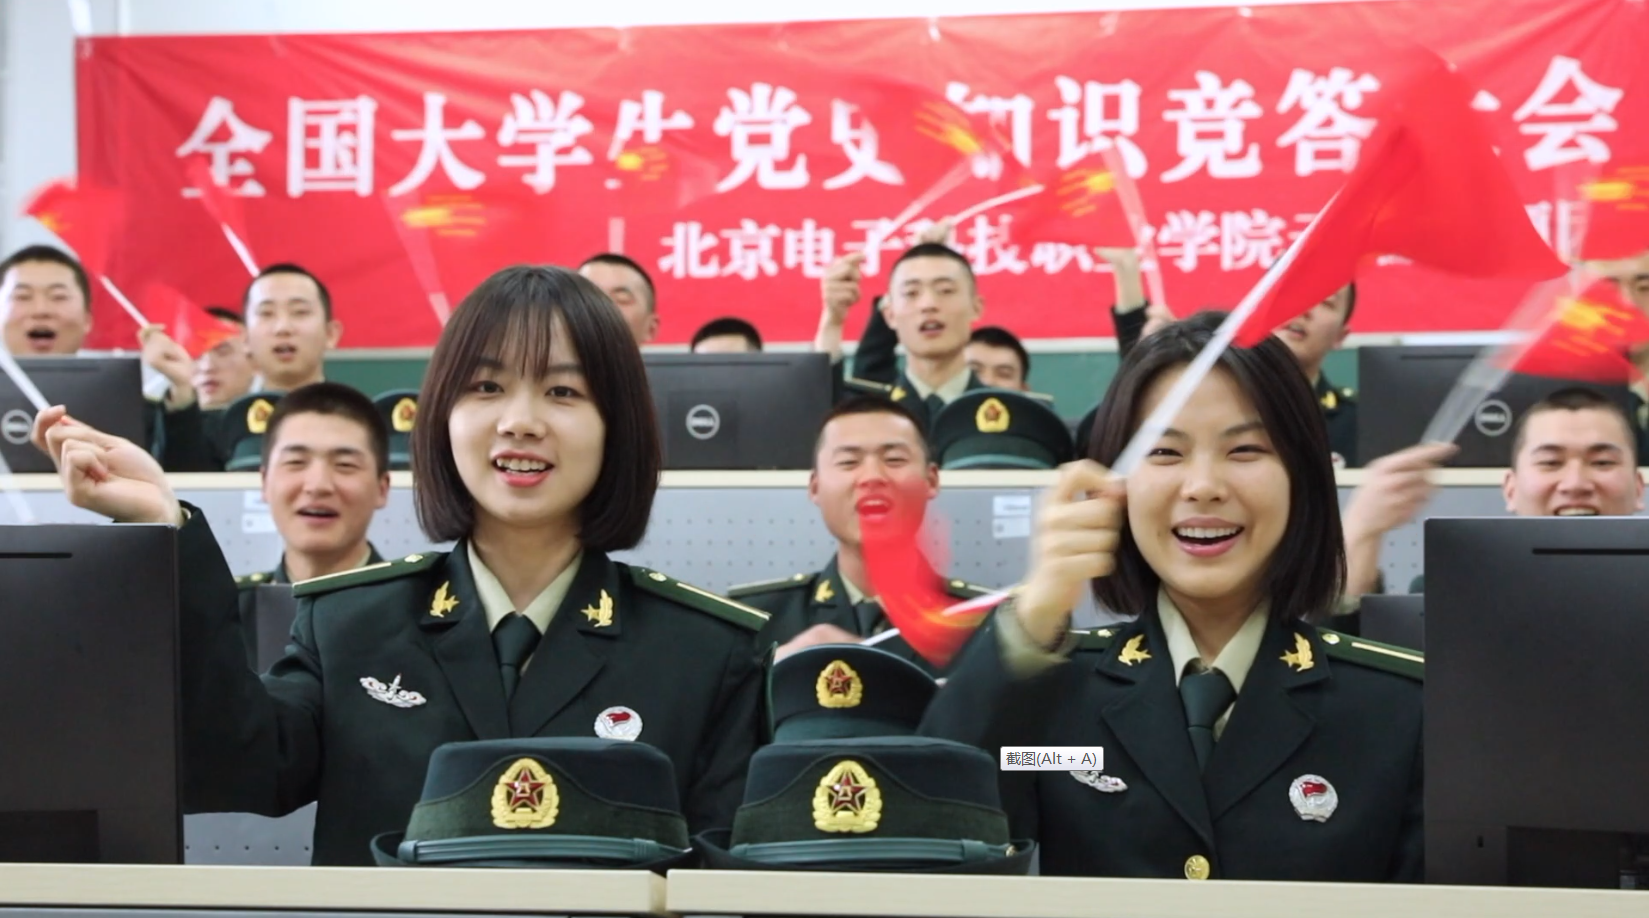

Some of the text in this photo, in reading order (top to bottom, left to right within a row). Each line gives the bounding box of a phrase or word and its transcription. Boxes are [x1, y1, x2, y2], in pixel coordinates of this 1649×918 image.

[175, 55, 1624, 199] 全国大学生党史识竞答会
